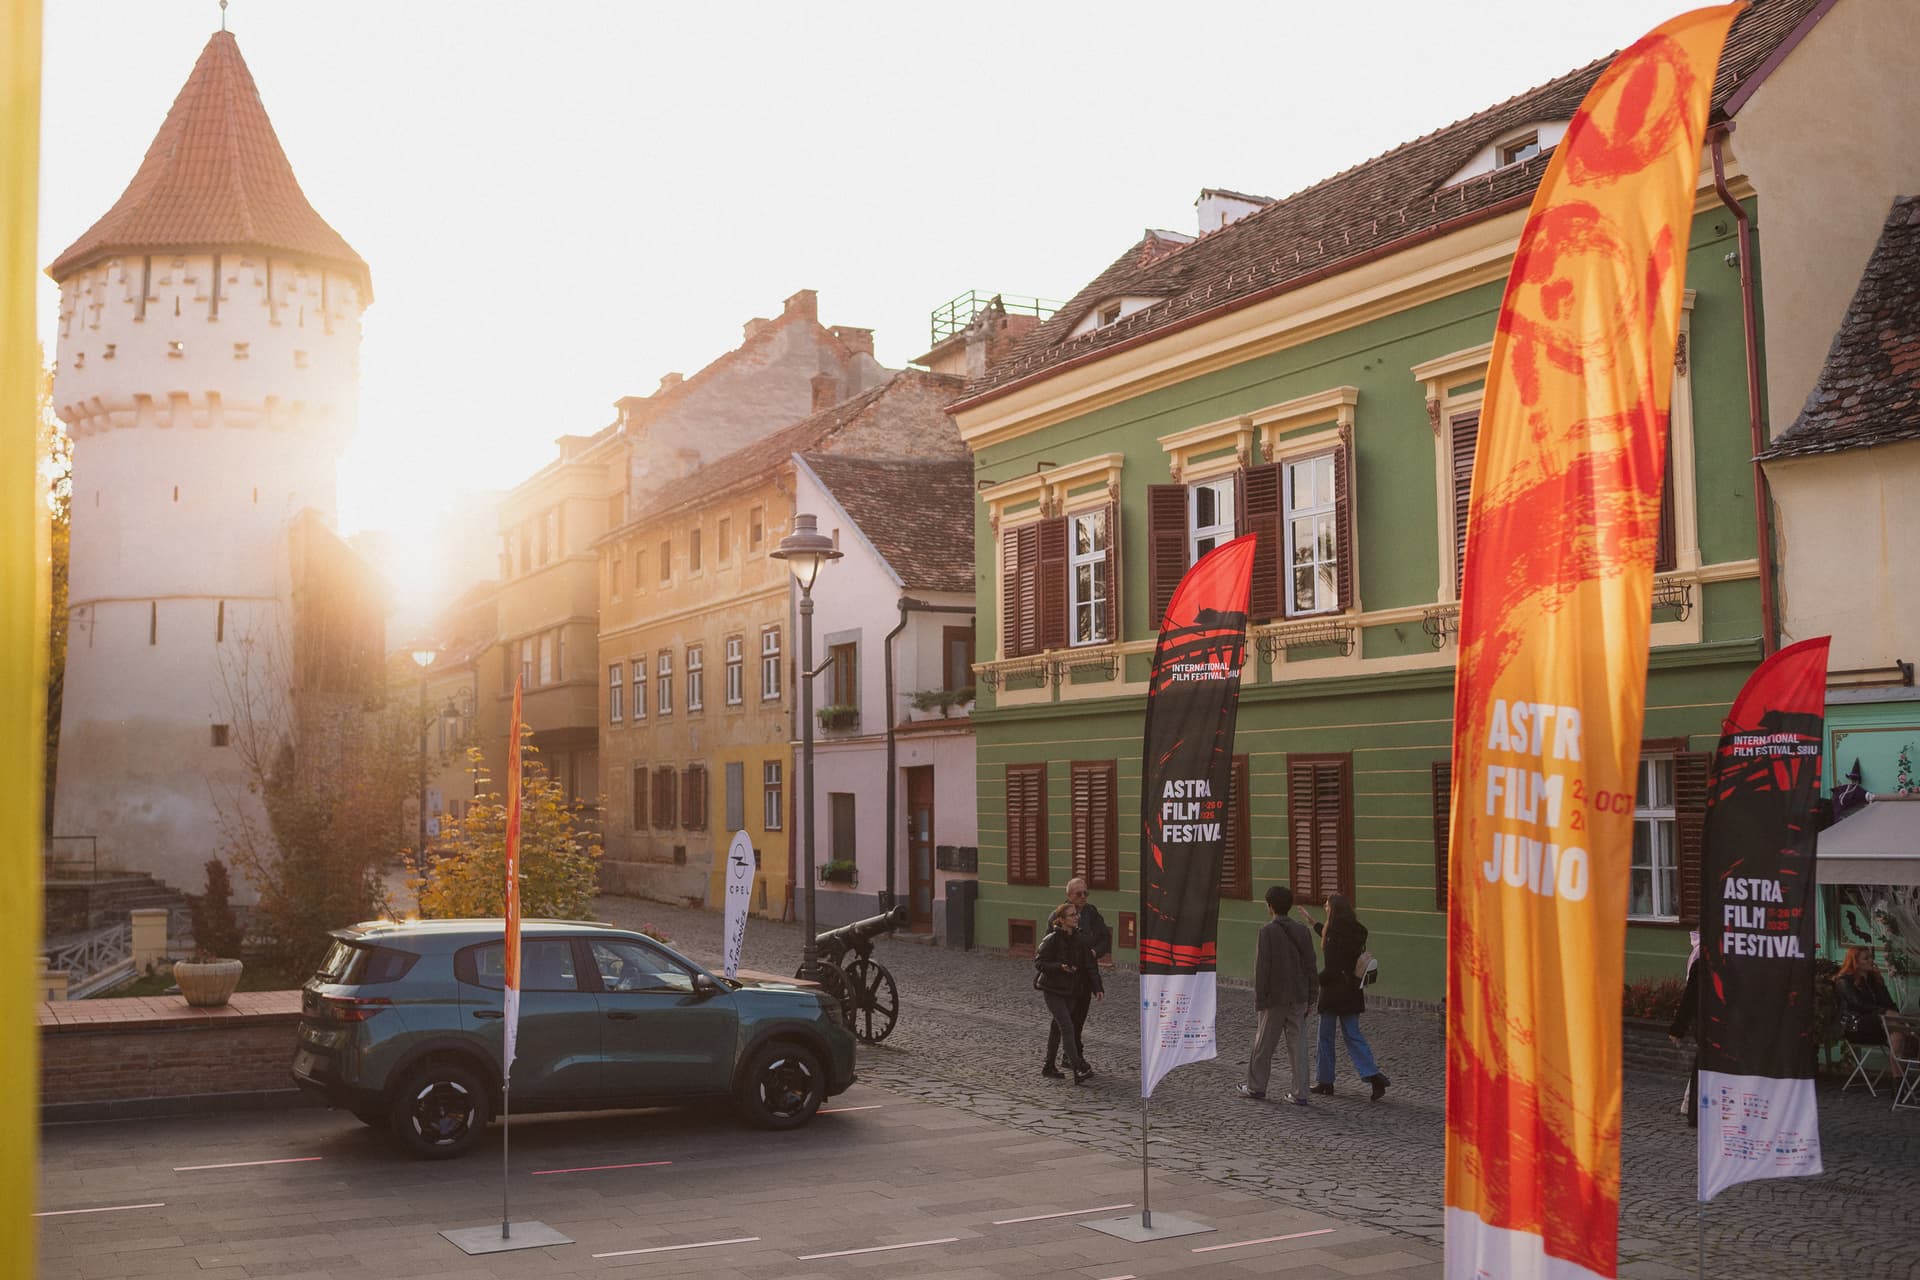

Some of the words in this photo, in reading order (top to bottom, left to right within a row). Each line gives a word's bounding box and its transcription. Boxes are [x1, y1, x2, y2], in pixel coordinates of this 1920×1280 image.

[1172, 662, 1230, 672] INTERNATIONAL
[1172, 673, 1190, 681] FILM
[1734, 747, 1753, 756] FILM
[1163, 779, 1211, 798] ASTRA
[1486, 765, 1564, 828] FILM
[1163, 802, 1200, 820] FILM
[1163, 823, 1221, 843] FESTIVA
[729, 885, 750, 895] OPEL
[1723, 877, 1783, 902] ASTRA
[1724, 905, 1766, 929] FILM
